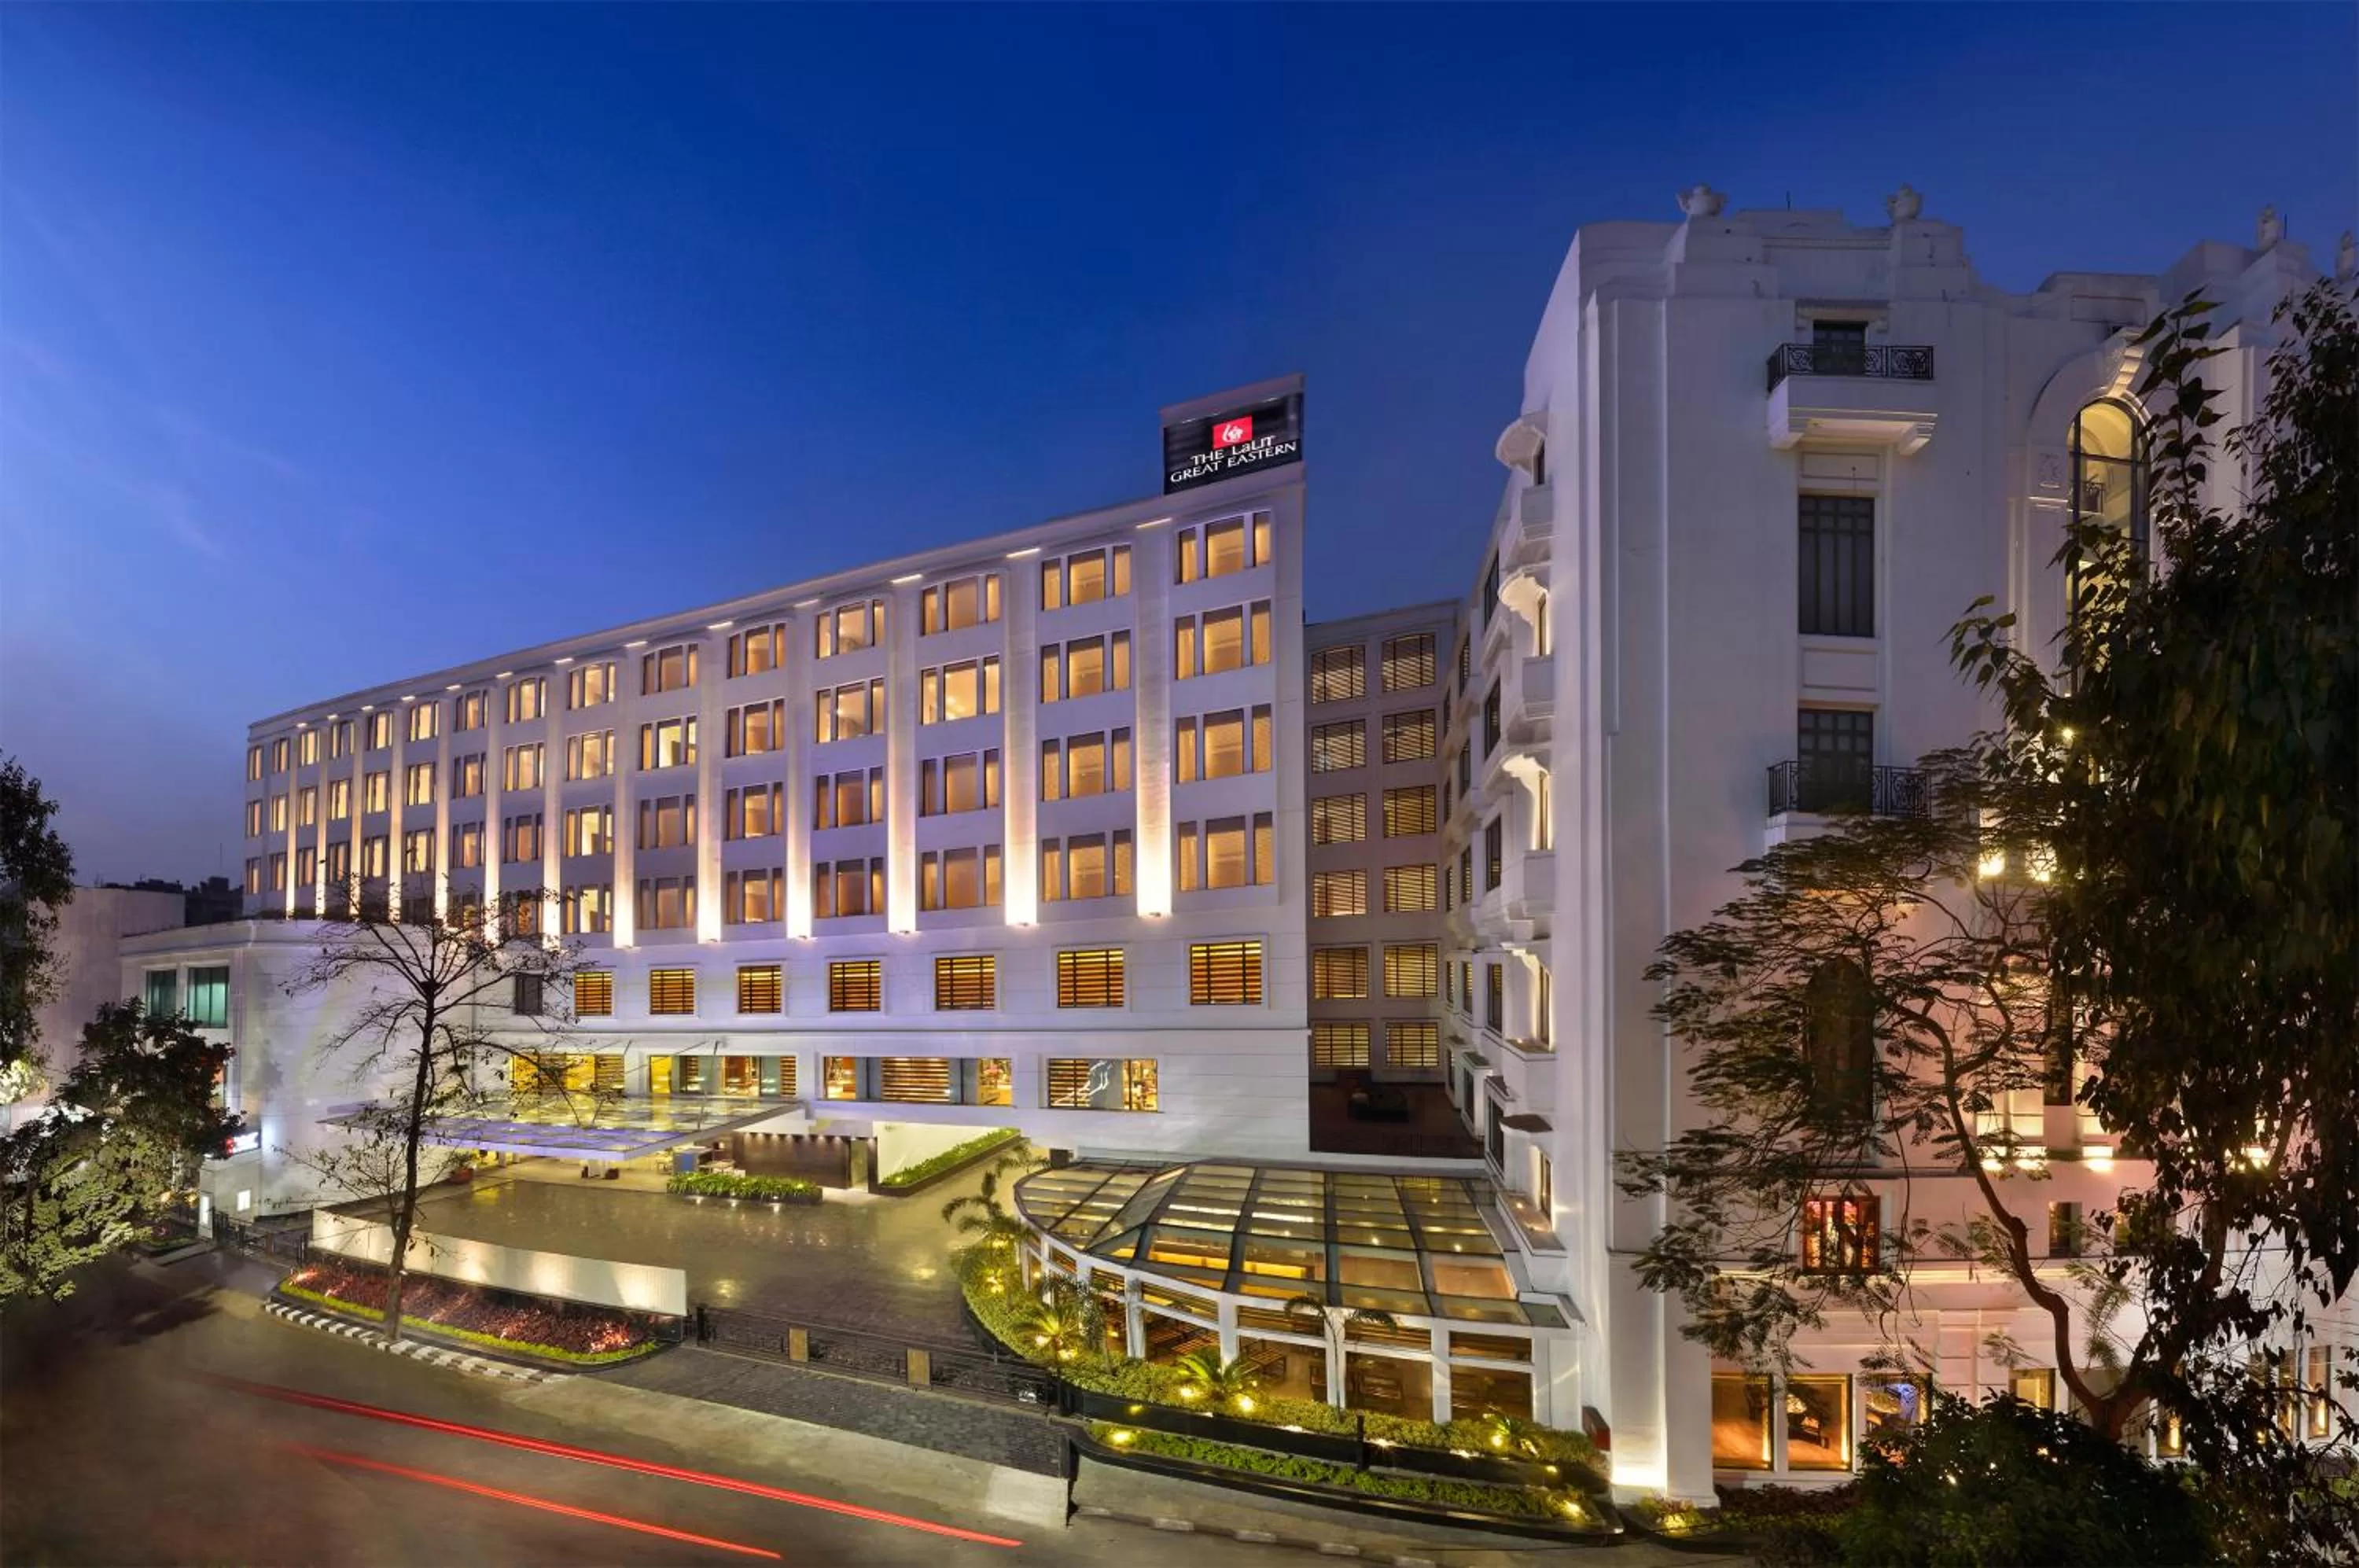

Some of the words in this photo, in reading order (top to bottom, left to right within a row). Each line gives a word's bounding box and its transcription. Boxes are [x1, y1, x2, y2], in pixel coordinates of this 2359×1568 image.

[1170, 461, 1222, 482] GREAT
[1227, 441, 1296, 467] EASTERN
[1191, 449, 1224, 466] THE
